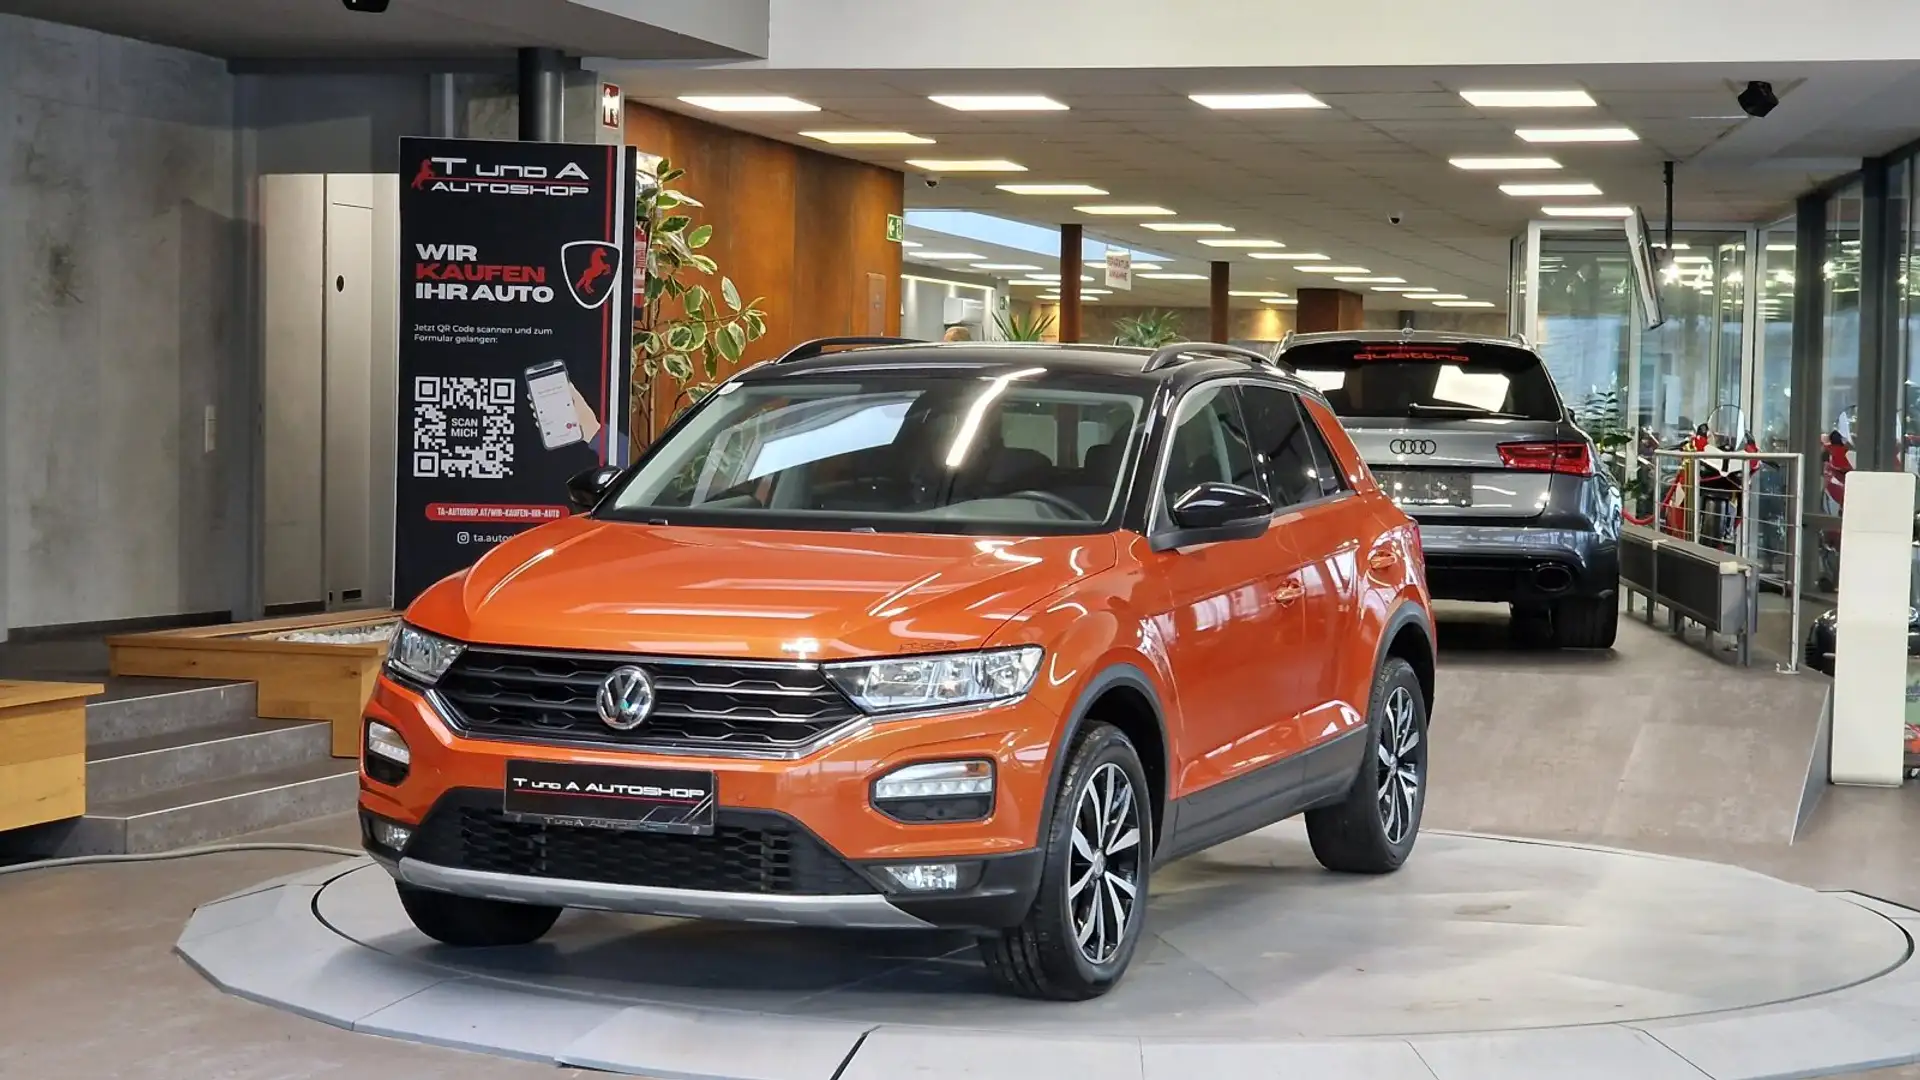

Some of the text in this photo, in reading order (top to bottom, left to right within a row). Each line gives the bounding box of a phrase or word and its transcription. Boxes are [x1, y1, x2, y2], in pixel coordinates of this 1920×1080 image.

[431, 156, 467, 176] T
[554, 161, 590, 180] A
[431, 181, 590, 196] AUTOSHOP
[415, 243, 478, 262] WIR
[415, 263, 546, 283] KAUFEN
[415, 283, 555, 304] IHR AUTO
[414, 323, 553, 336] Jetzt QR Code scannen und zum
[414, 333, 499, 345] Formular gelangen:
[1353, 351, 1469, 362] quattro
[451, 417, 478, 427] SCAN
[451, 428, 478, 438] MICH
[513, 777, 528, 788] T
[565, 782, 581, 792] A
[585, 783, 705, 799] AUTOSHOP
